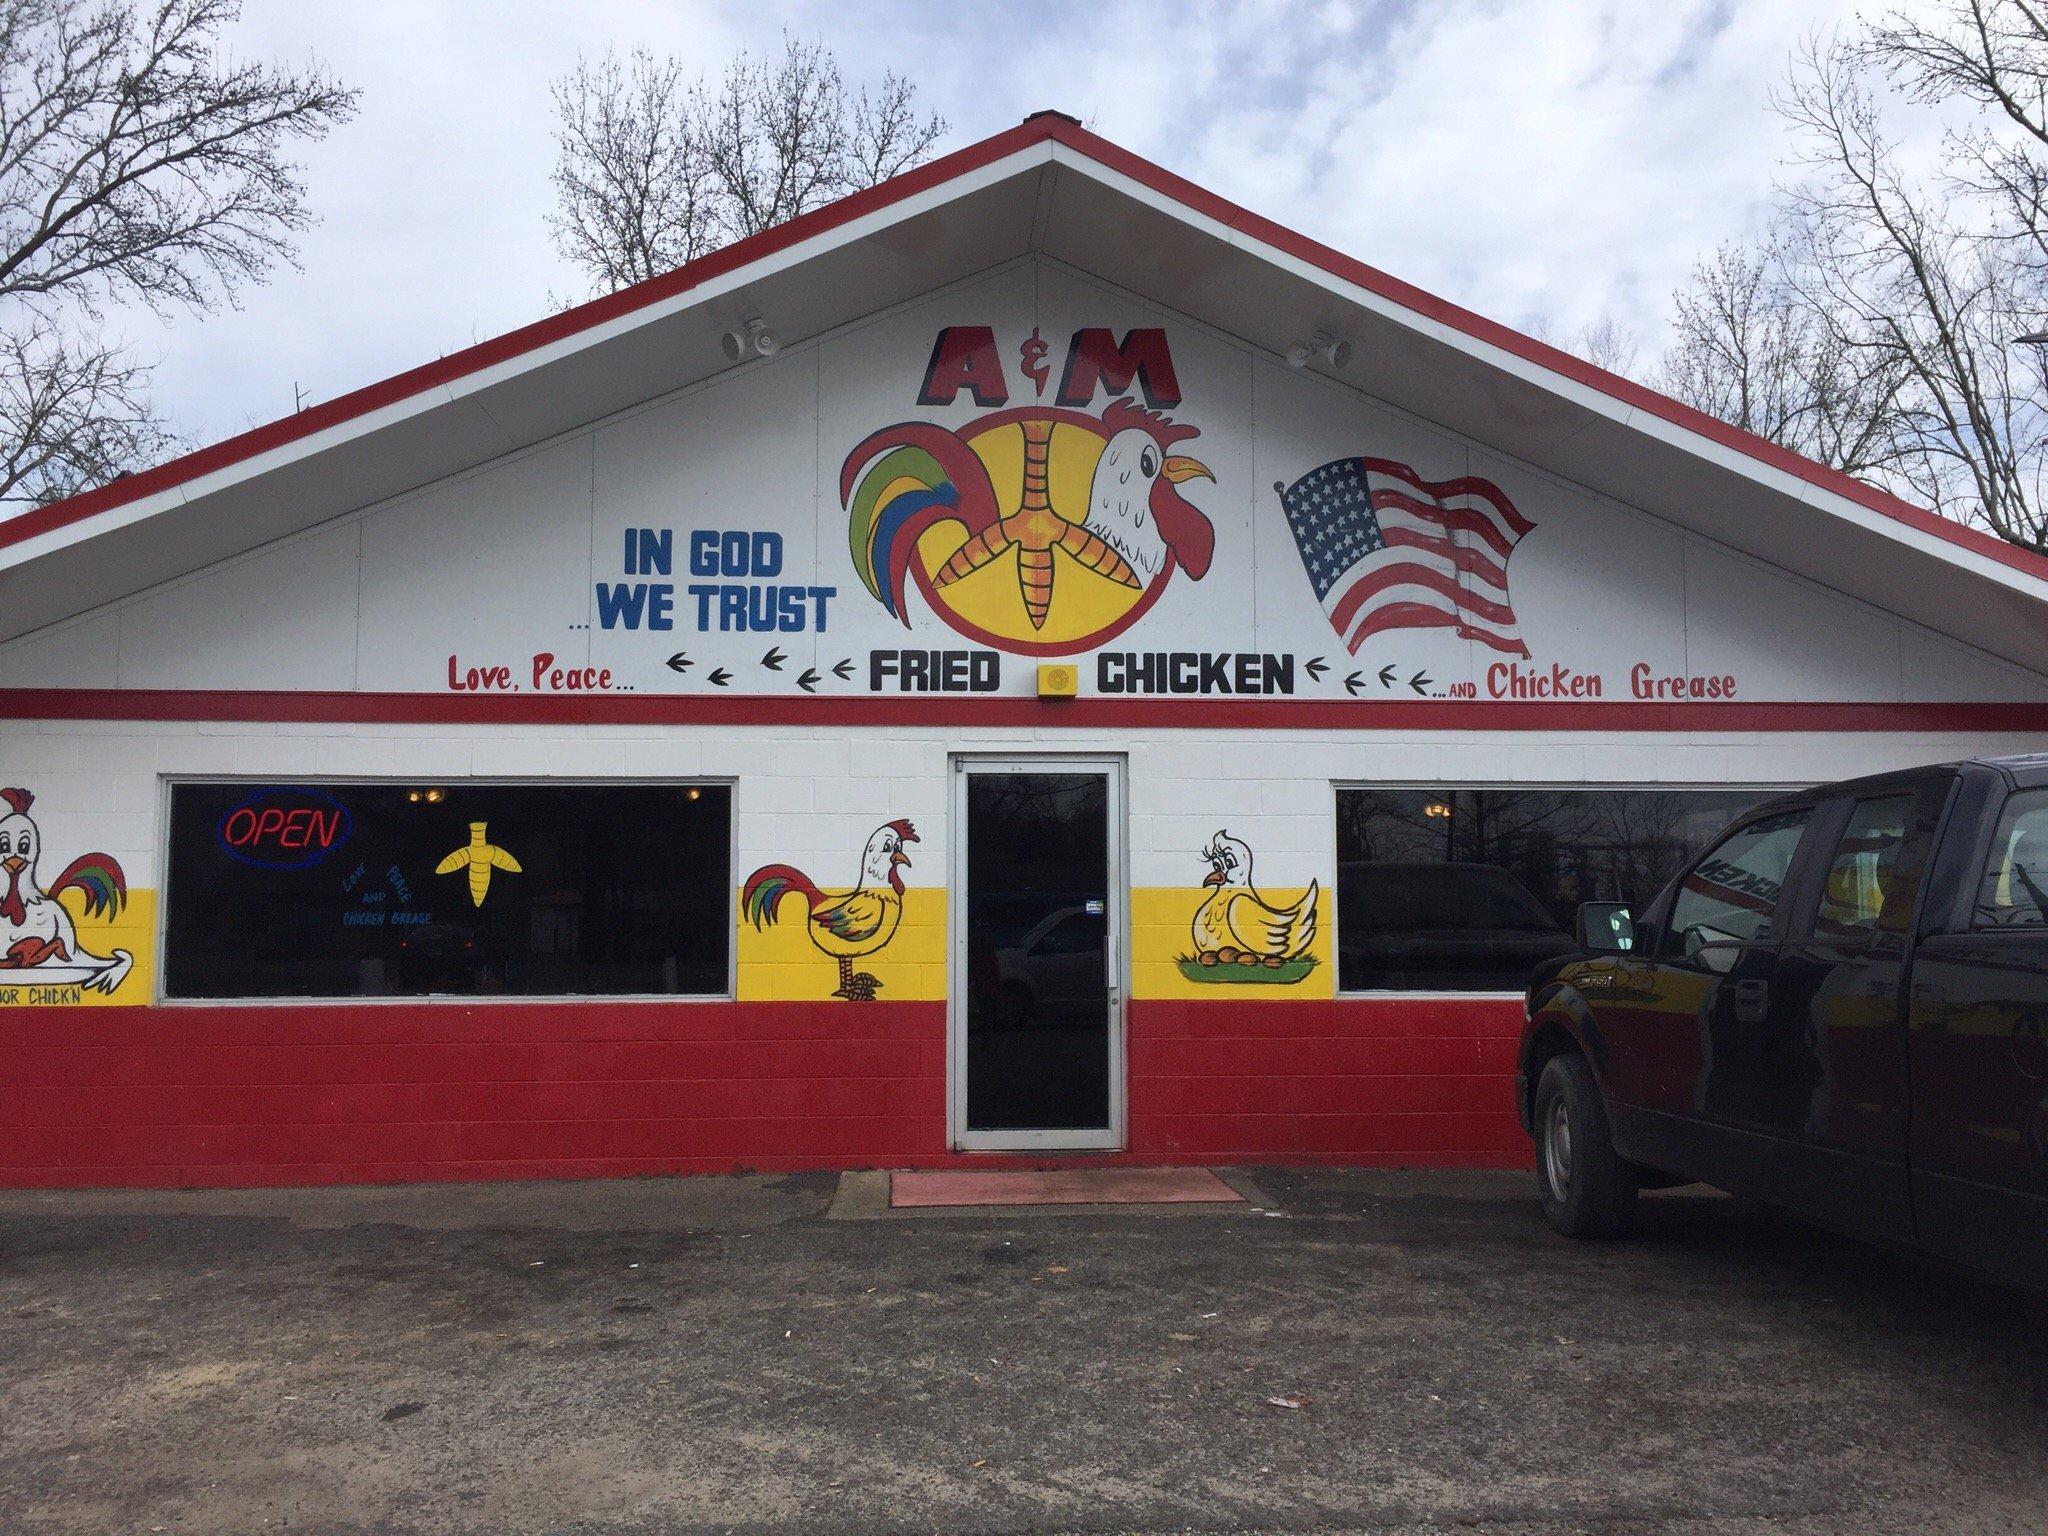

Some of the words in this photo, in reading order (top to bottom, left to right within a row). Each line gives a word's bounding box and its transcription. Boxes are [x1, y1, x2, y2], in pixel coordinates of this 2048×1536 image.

[624, 528, 673, 576] IN
[690, 530, 783, 577] GOD
[688, 584, 837, 633] TRUST
[448, 654, 519, 692] Love,
[869, 650, 1000, 692] FRIED
[1097, 652, 1294, 694] CHICKEN
[1631, 662, 1737, 699] Grease
[225, 808, 341, 848] OPEN
[362, 891, 386, 904] AND
[344, 910, 385, 927] CHICKEN
[391, 910, 431, 925] GREASE
[0, 988, 19, 1005] OR
